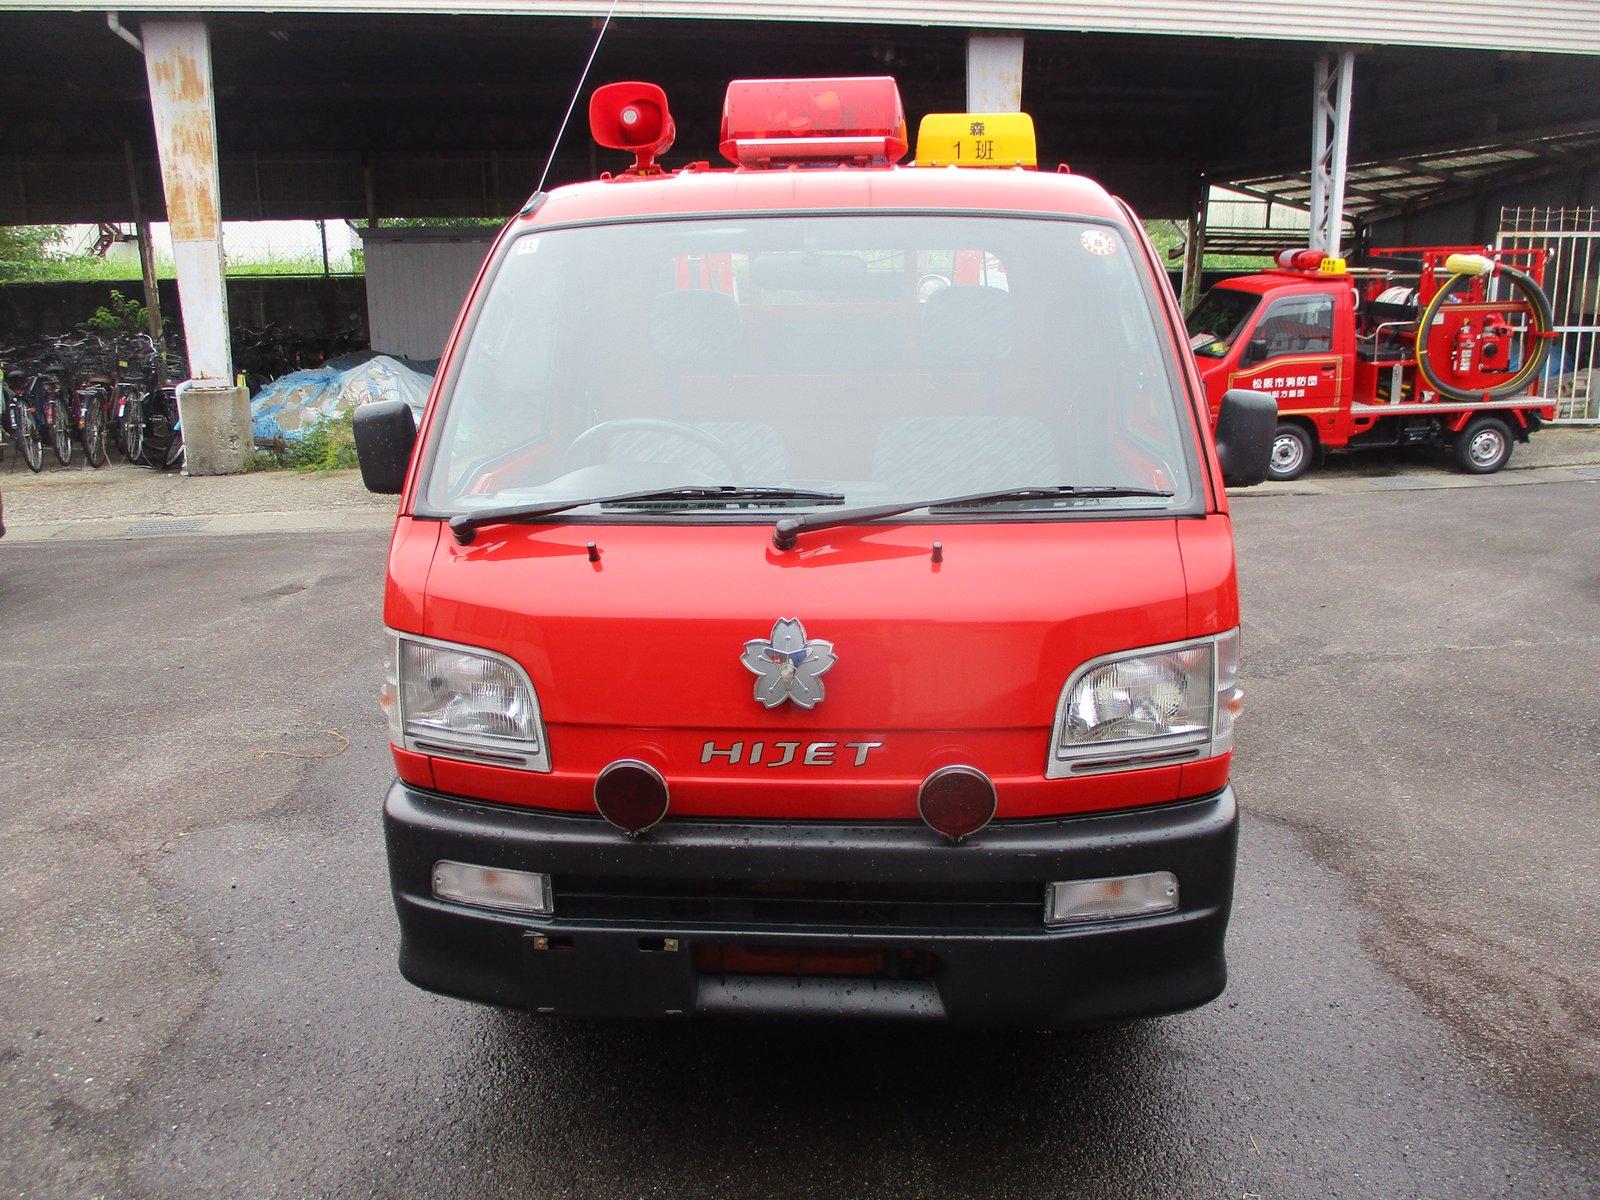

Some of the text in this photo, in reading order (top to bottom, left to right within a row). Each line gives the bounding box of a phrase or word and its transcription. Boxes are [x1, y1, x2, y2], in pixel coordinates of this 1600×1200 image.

[970, 121, 985, 136] 森
[1252, 375, 1318, 389] 松阪市消防団
[700, 741, 883, 767] HIJET
